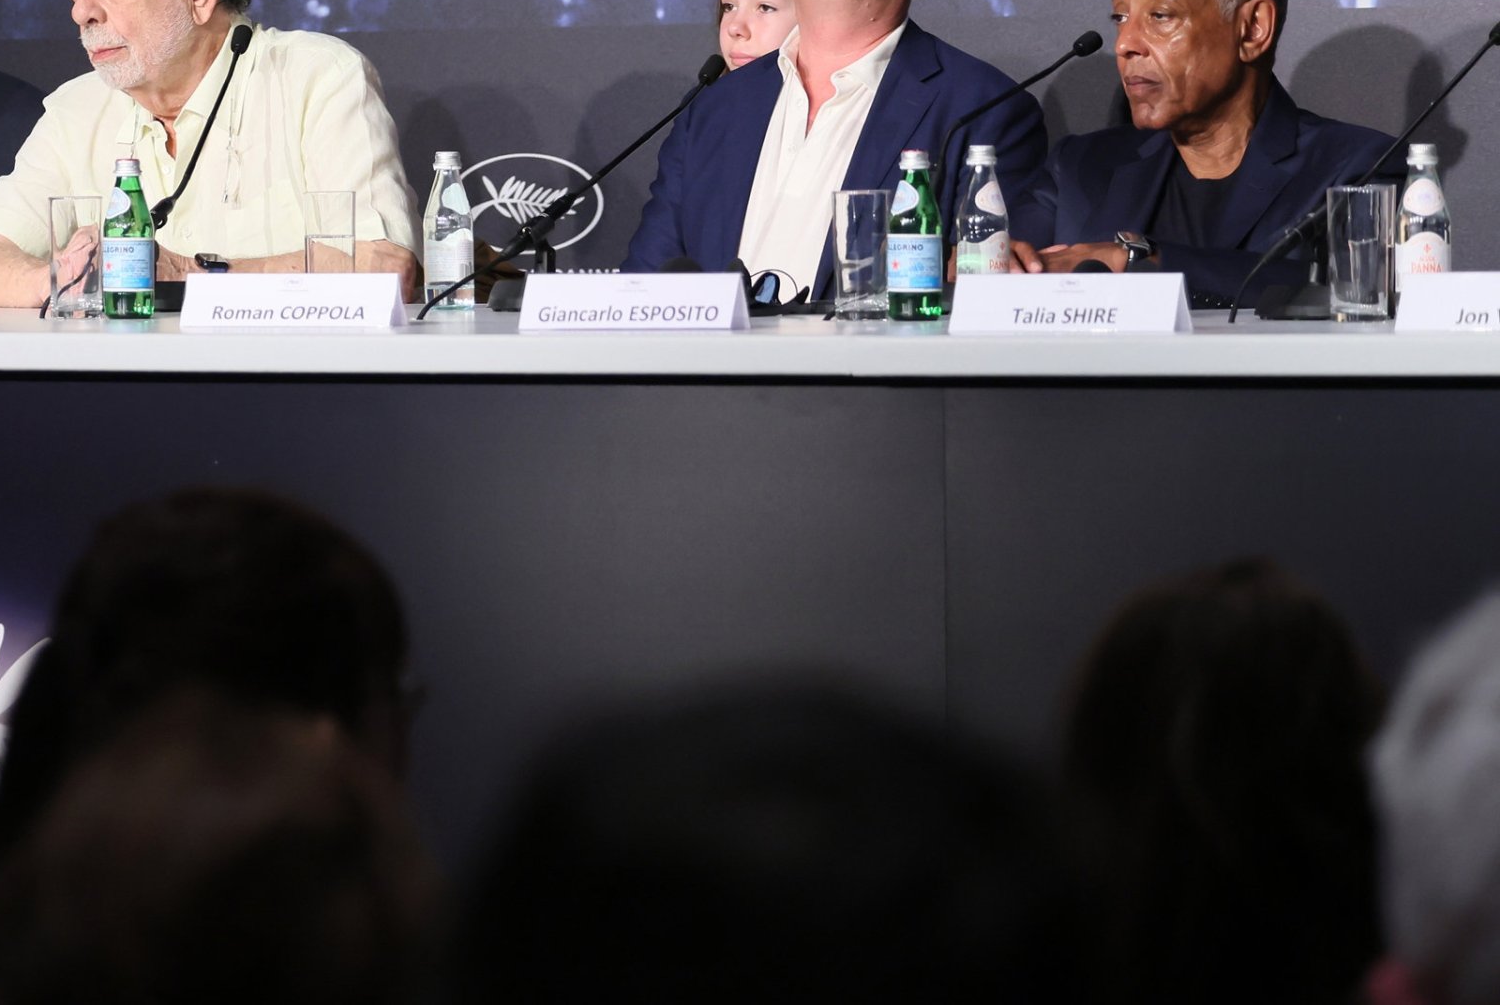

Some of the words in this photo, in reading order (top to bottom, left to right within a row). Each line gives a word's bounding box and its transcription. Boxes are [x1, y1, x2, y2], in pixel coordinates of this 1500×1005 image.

[211, 305, 274, 320] Roman
[280, 306, 365, 321] COPPOLA
[538, 305, 623, 323] Giancarlo
[629, 305, 719, 322] ESPOSITO
[1012, 307, 1056, 324] Talia
[1061, 307, 1118, 324] SHIRE
[1455, 308, 1489, 325] Jon
